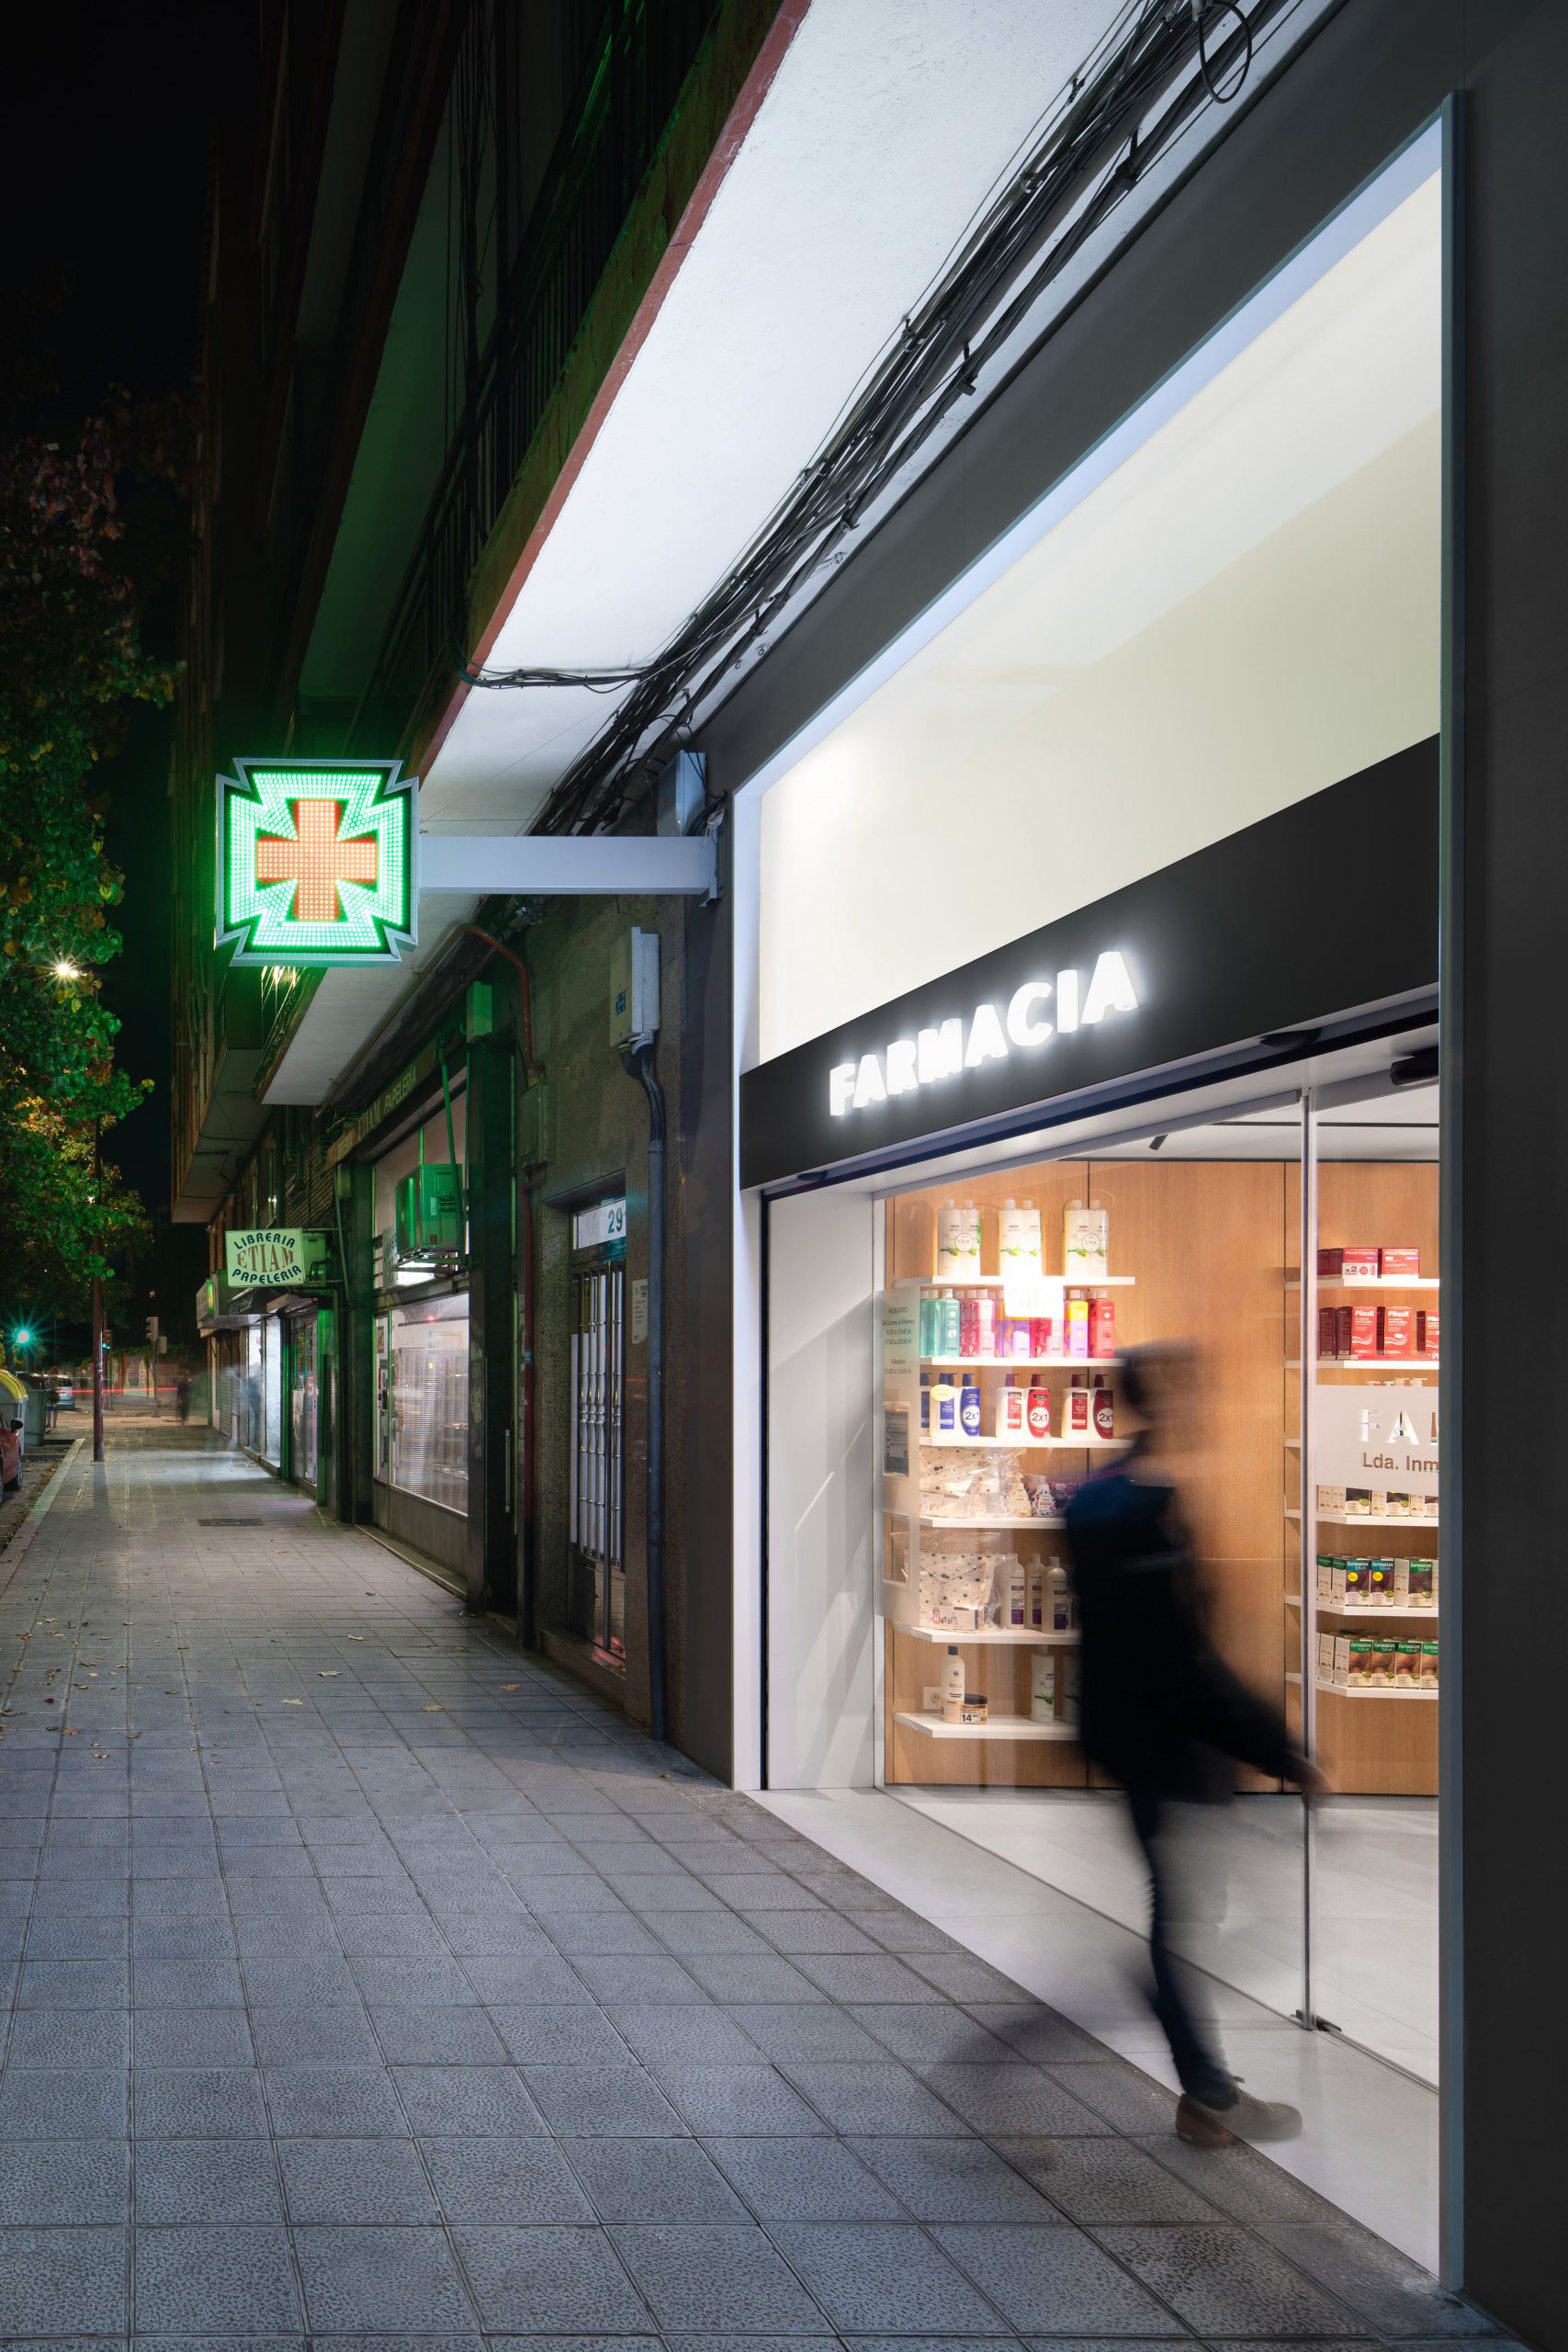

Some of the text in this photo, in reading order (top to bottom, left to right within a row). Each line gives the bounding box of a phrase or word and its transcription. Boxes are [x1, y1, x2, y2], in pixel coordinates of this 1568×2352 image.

[829, 951, 1139, 1115] FARMACIA
[607, 1206, 624, 1234] 29
[233, 1232, 296, 1250] LIBRERIA
[235, 1243, 295, 1273] ETIAM
[231, 1265, 302, 1284] PAPELERIA
[1032, 1412, 1048, 1421] 2x1
[1363, 1453, 1399, 1470] Lda.
[961, 1713, 973, 1723] 14
